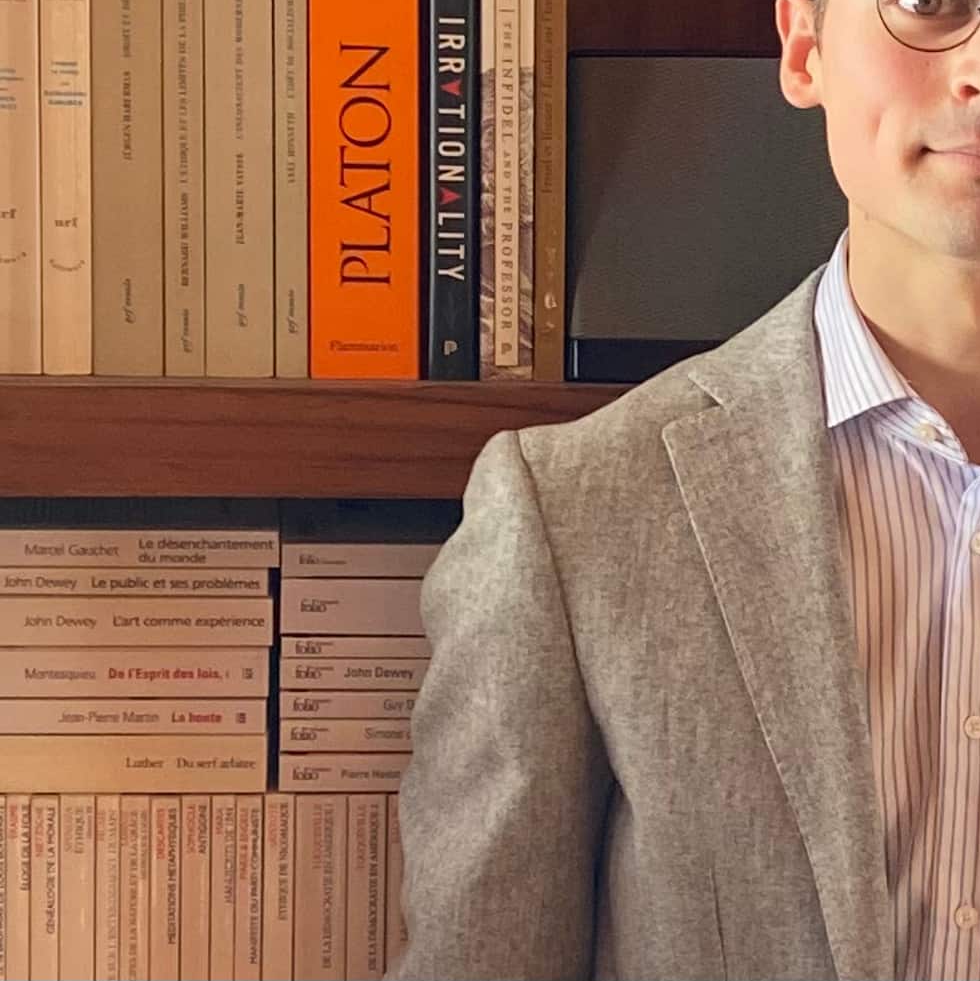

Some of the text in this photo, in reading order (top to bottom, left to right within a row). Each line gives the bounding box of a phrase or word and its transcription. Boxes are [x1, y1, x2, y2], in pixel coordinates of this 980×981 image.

[503, 20, 513, 49] THE
[502, 59, 515, 143] INFIDEL
[338, 41, 392, 288] PLATON
[503, 150, 512, 180] AND
[503, 186, 513, 214] THE
[501, 221, 514, 331] PROFESSOR
[328, 340, 400, 353] Flammarion
[24, 543, 65, 557] Marcel
[138, 537, 275, 554] Le désenchantement
[138, 553, 208, 564] du monde
[4, 575, 260, 592] John Dewey Le public et ses problèmes
[24, 614, 266, 632] John Dewey L'art comme expérience
[108, 667, 125, 680] De
[128, 666, 170, 683] l'Esprit
[172, 667, 195, 680] des
[344, 667, 373, 679] John
[375, 666, 414, 680] Dewey
[171, 711, 187, 724] La
[125, 756, 164, 769] Luther
[176, 756, 195, 769] Du
